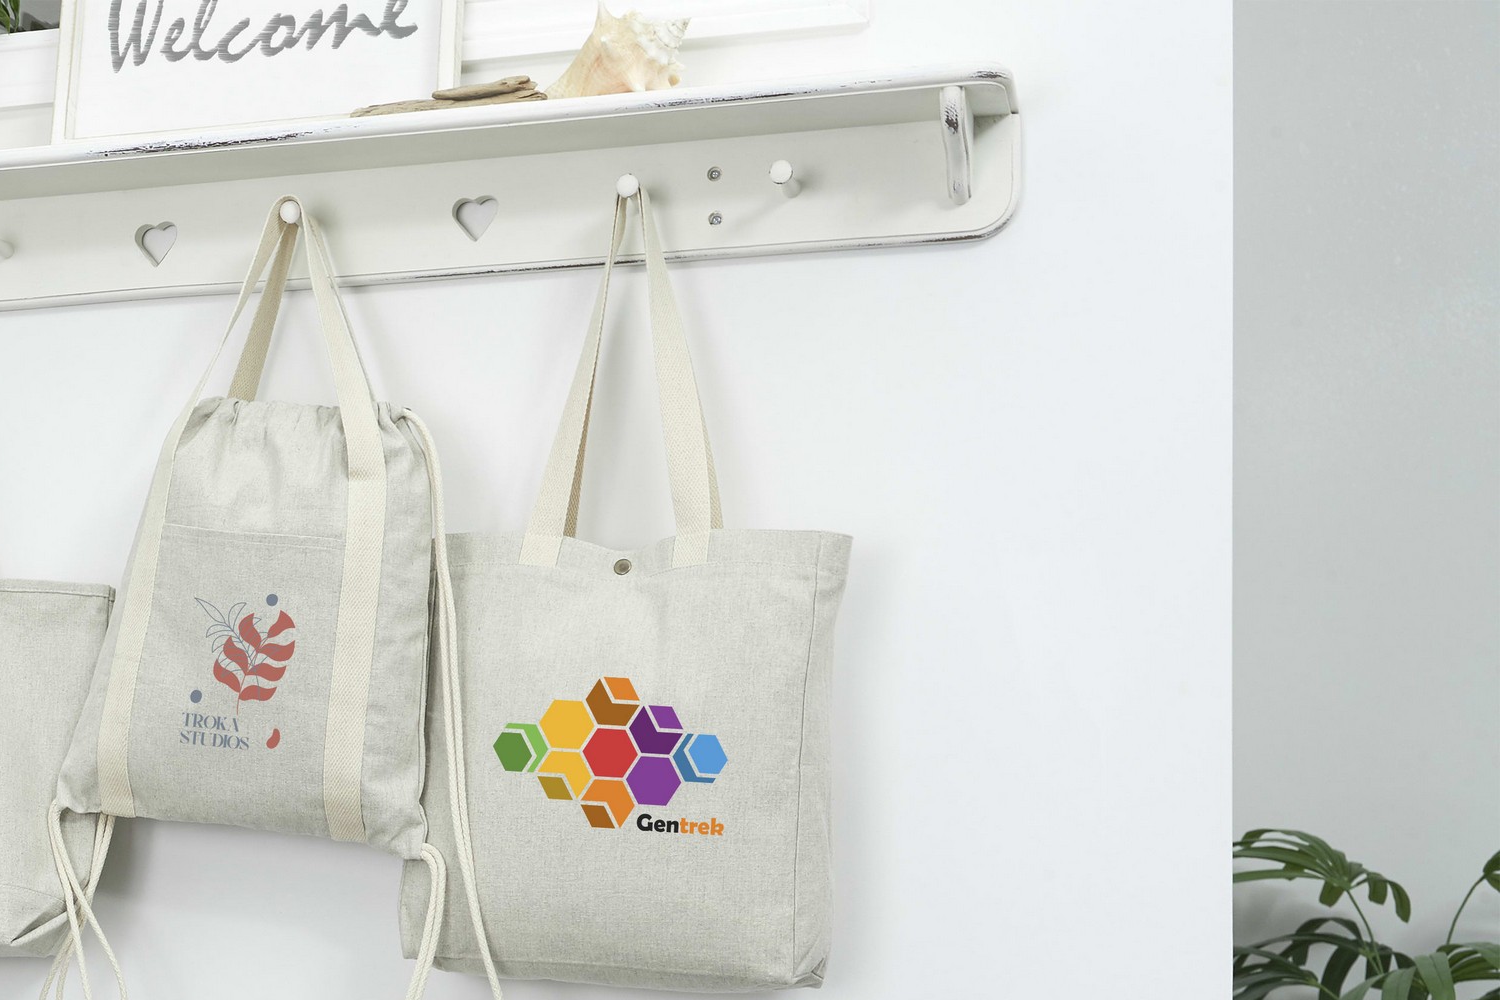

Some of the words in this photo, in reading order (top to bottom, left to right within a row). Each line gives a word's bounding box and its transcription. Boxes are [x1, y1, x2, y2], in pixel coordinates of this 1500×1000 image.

[108, 0, 419, 74] Welcome
[182, 711, 240, 733] TROKA
[179, 730, 251, 751] STUDIOS
[636, 813, 725, 837] Gentrek
